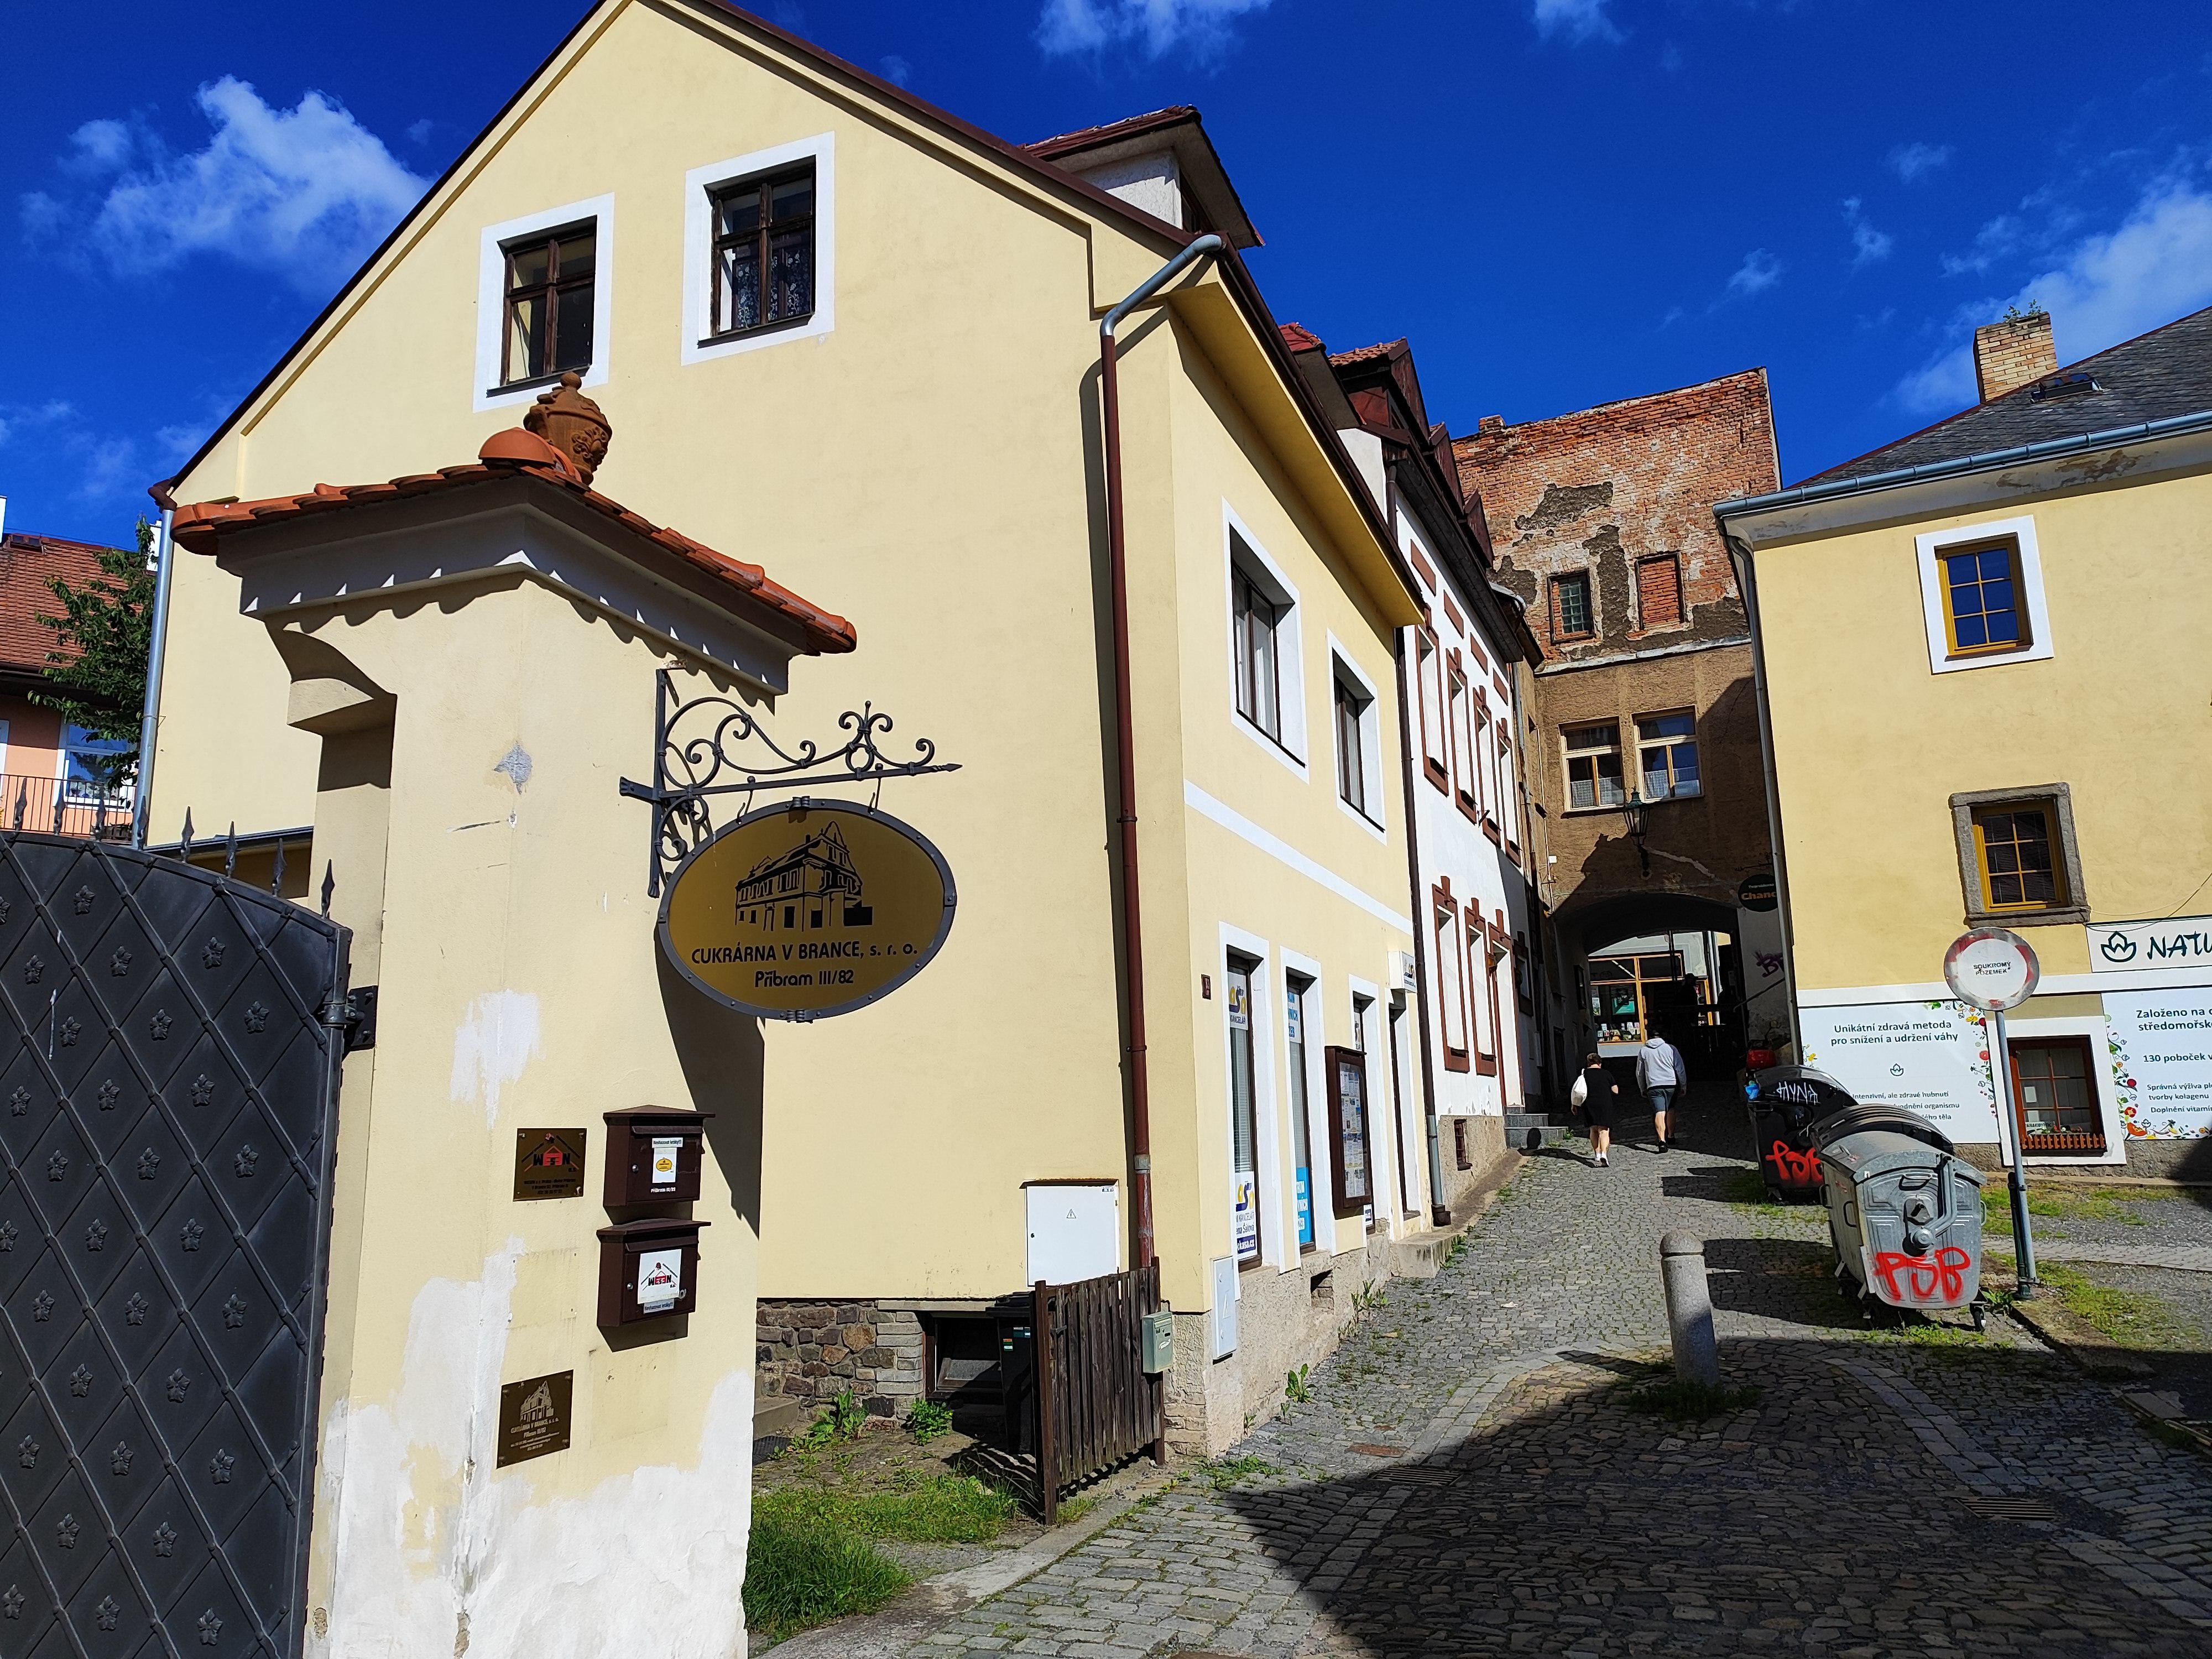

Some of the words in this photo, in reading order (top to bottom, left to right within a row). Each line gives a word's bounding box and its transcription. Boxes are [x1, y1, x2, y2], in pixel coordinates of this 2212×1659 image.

[691, 942, 776, 964] CUKRÁRNA
[781, 943, 794, 961] V
[798, 941, 864, 959] BRANCE,
[754, 969, 813, 988] Příbram
[818, 969, 854, 985] III/82
[2136, 1008, 2188, 1018] Založeno
[1834, 1023, 1875, 1033] Unikátní
[1877, 1021, 1910, 1031] zdravá
[1912, 1020, 1952, 1030] metoda
[2138, 1019, 2212, 1031] středomořsk
[1831, 1037, 1847, 1046] pro
[1849, 1034, 1883, 1044] snížení
[1895, 1032, 1932, 1042] udržení
[1934, 1032, 1958, 1042] váhy
[2143, 1054, 2161, 1062] 130
[2163, 1052, 2206, 1064] poboček
[2147, 1083, 2177, 1092] Správná
